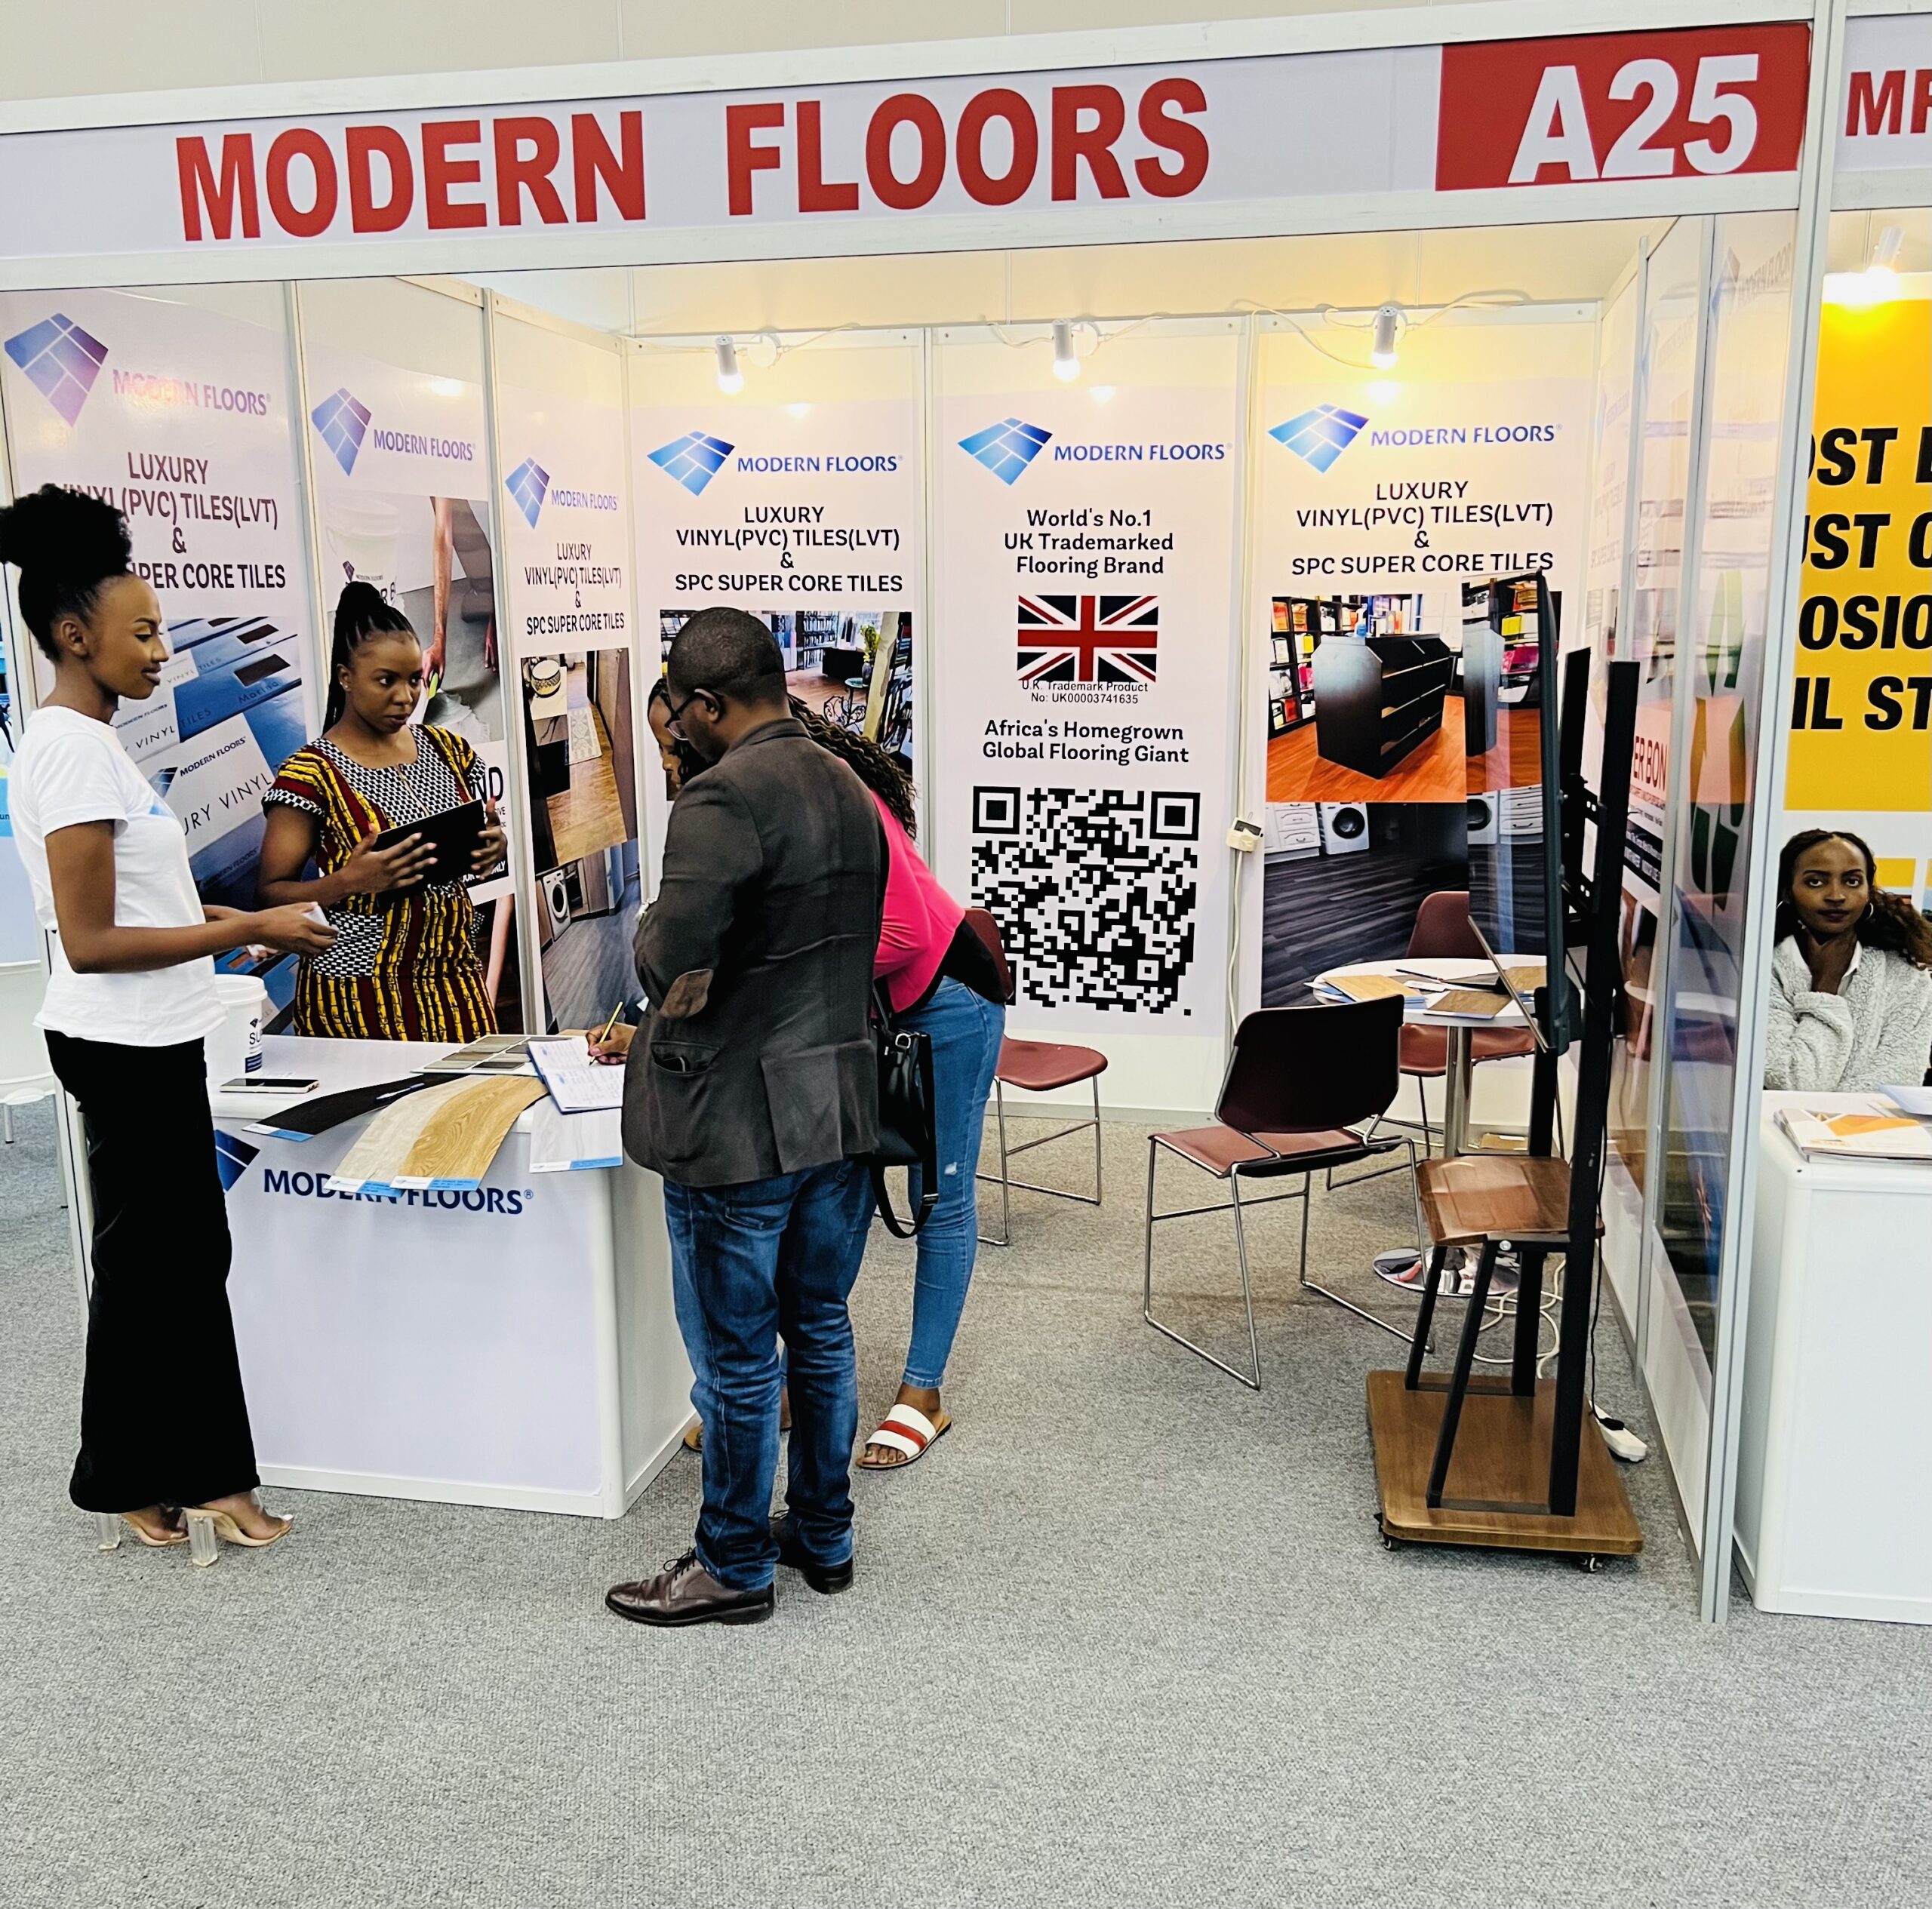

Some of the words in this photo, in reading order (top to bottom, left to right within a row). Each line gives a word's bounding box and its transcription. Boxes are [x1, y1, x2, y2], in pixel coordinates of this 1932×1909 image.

[1507, 54, 1759, 184] A25
[176, 110, 646, 241] MODERN
[726, 77, 1209, 216] FLOORS
[374, 429, 428, 455] MODERN
[1371, 428, 1466, 446] MODERN
[737, 456, 820, 472] MODERN
[1054, 445, 1143, 461] MODERN
[128, 452, 208, 484] LUXURY
[552, 490, 589, 509] MODERN
[590, 493, 617, 511] FLOORS
[1377, 481, 1469, 501] LUXURY
[180, 493, 278, 530] TILES(LVT)
[744, 506, 824, 524] LUXURY
[1027, 508, 1104, 527] World's
[1109, 510, 1152, 527] No.1
[1297, 507, 1425, 530] VINYL(PVC)
[1431, 503, 1554, 527] TILES(LVT)
[172, 527, 187, 554] &
[675, 529, 788, 552] VINYL(PVC)
[793, 529, 900, 552] TILES(LVT)
[1004, 533, 1033, 550] UK
[1038, 533, 1174, 551] Trademarked
[1414, 530, 1430, 549] &
[557, 543, 592, 561] LUXURY
[780, 552, 795, 569] &
[132, 562, 179, 589] PER
[183, 563, 235, 589] CORE
[237, 564, 286, 589] TILES
[1017, 556, 1098, 579] Flooring
[1104, 557, 1164, 574] Brand
[1292, 558, 1335, 576] SPC
[1341, 556, 1416, 574] SUPER
[1422, 555, 1485, 573] CORE
[1490, 552, 1554, 571] TILES
[525, 567, 578, 590] VINYL(PVC)
[580, 567, 622, 589] TILES(LVT)
[675, 573, 714, 592] SPC
[718, 573, 783, 592] SUPER
[789, 574, 842, 592] CORE
[848, 574, 903, 592] TILES
[575, 590, 581, 608] &
[527, 616, 546, 635] SPC
[548, 614, 577, 634] SUPER
[579, 613, 601, 632] CORE
[603, 612, 625, 630] TILES
[1048, 680, 1103, 690] Trademark
[1106, 681, 1148, 691] Product
[1031, 693, 1048, 702] No:
[1052, 693, 1138, 703] UK00003741635
[136, 725, 175, 749] VINYL
[984, 719, 1058, 739] Africa's
[1063, 721, 1184, 742] Homegrown
[180, 752, 216, 777] MODERN
[983, 742, 1044, 759] Global
[1050, 743, 1131, 766] Flooring
[1134, 745, 1189, 763] Giant
[219, 773, 272, 810] VINYL
